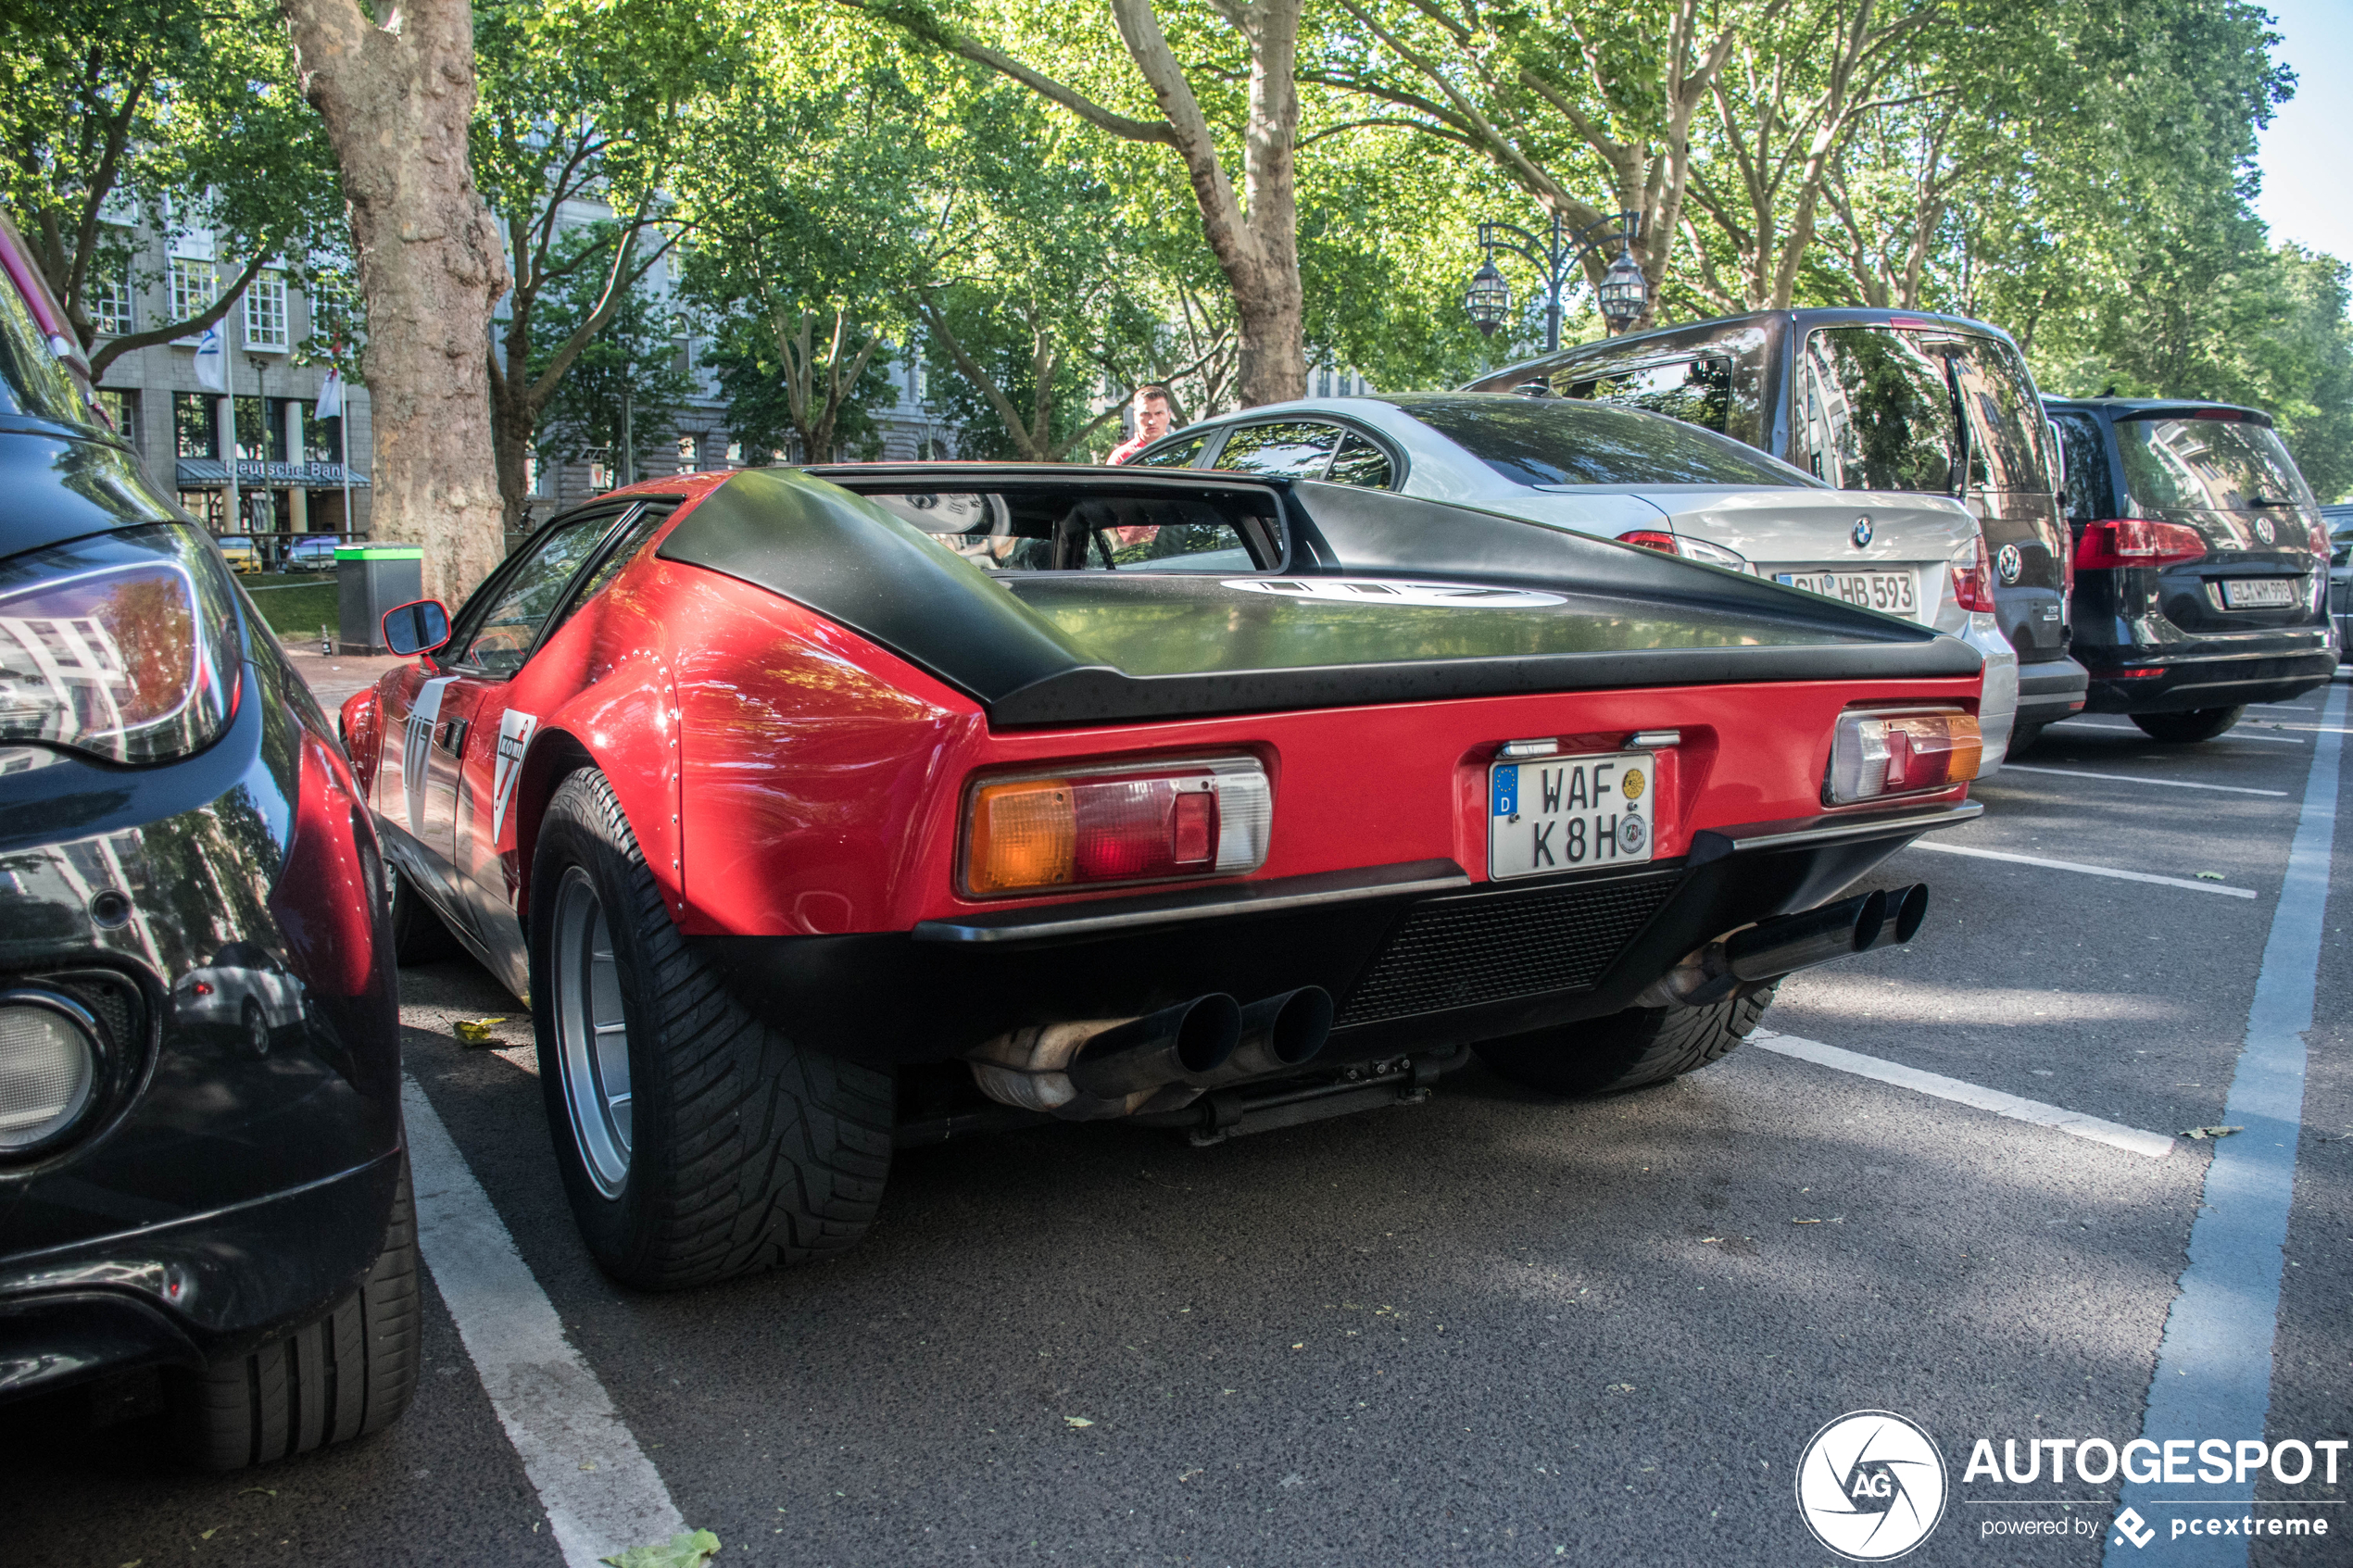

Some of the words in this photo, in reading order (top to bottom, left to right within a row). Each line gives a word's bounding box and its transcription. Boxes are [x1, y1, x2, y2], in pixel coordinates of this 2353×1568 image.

[1839, 577, 1869, 608] HB
[1872, 576, 1912, 608] 593
[2231, 582, 2249, 601] GL
[500, 737, 522, 759] KONI
[1541, 762, 1615, 814] WAF
[1501, 797, 1510, 812] D
